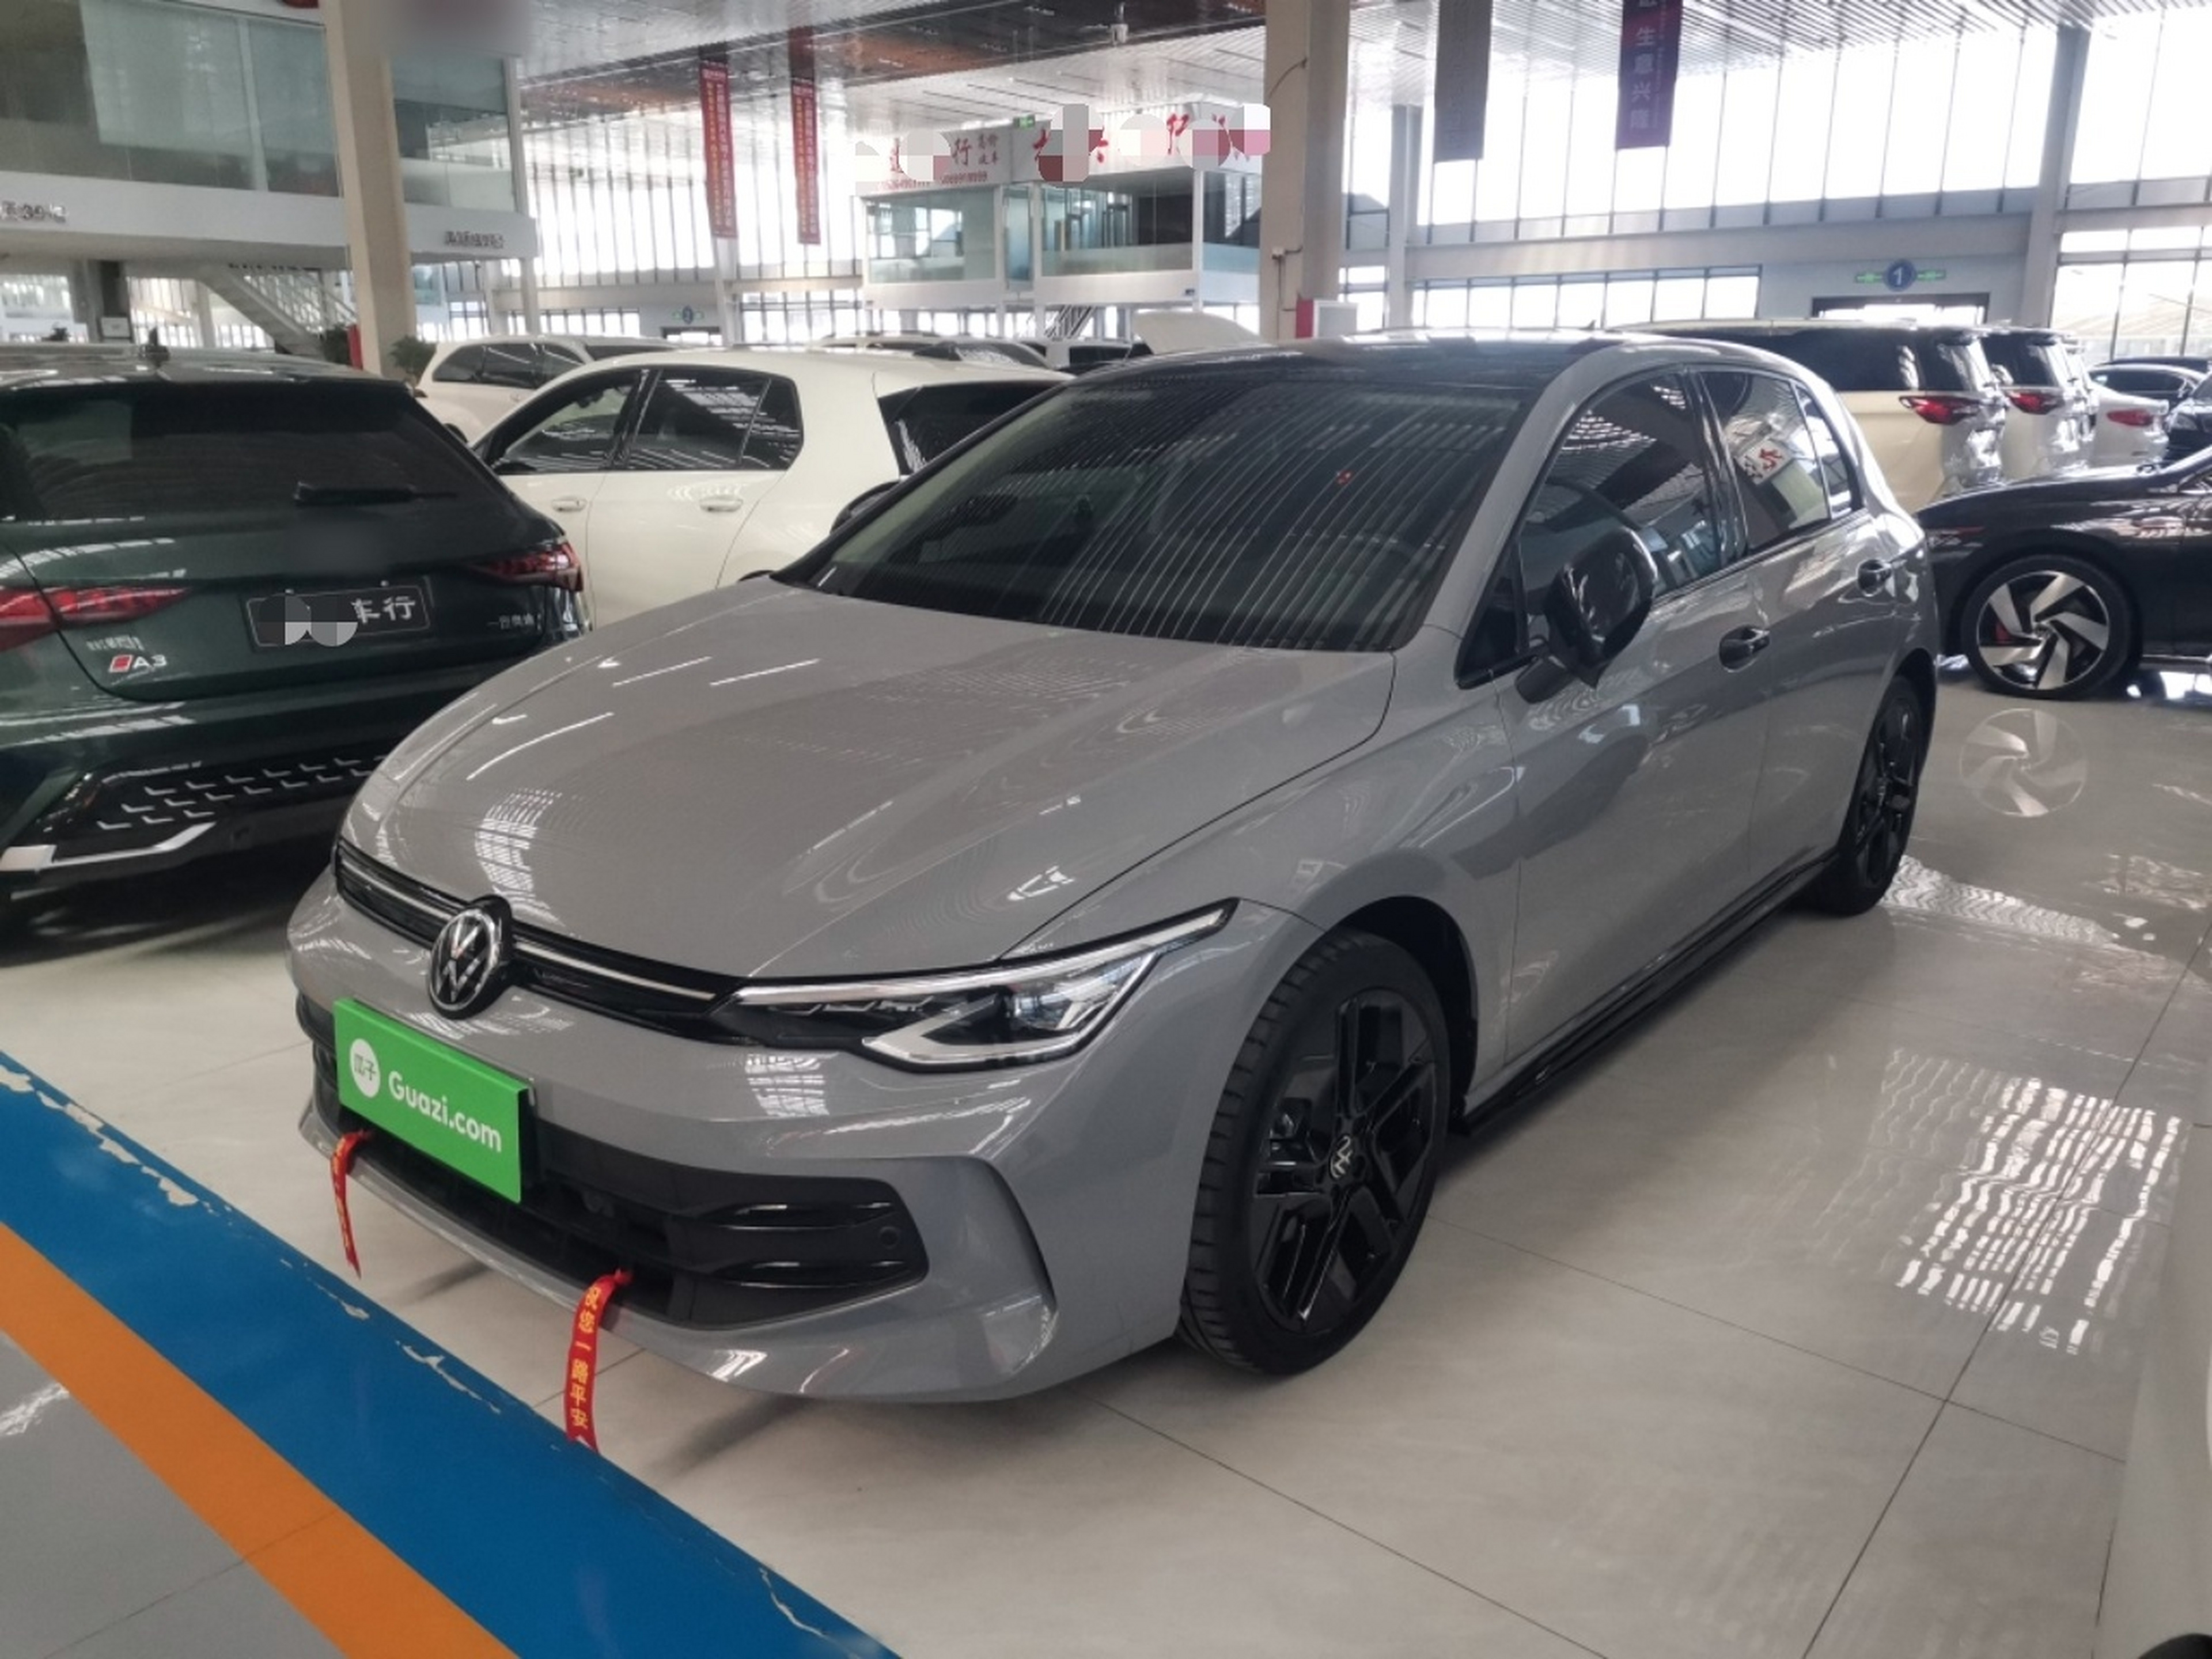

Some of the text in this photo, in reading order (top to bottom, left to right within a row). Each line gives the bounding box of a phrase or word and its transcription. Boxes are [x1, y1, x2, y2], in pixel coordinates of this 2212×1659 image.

[1893, 267, 1904, 286] 1
[132, 654, 168, 669] A3
[388, 1071, 502, 1153] Guazi.com
